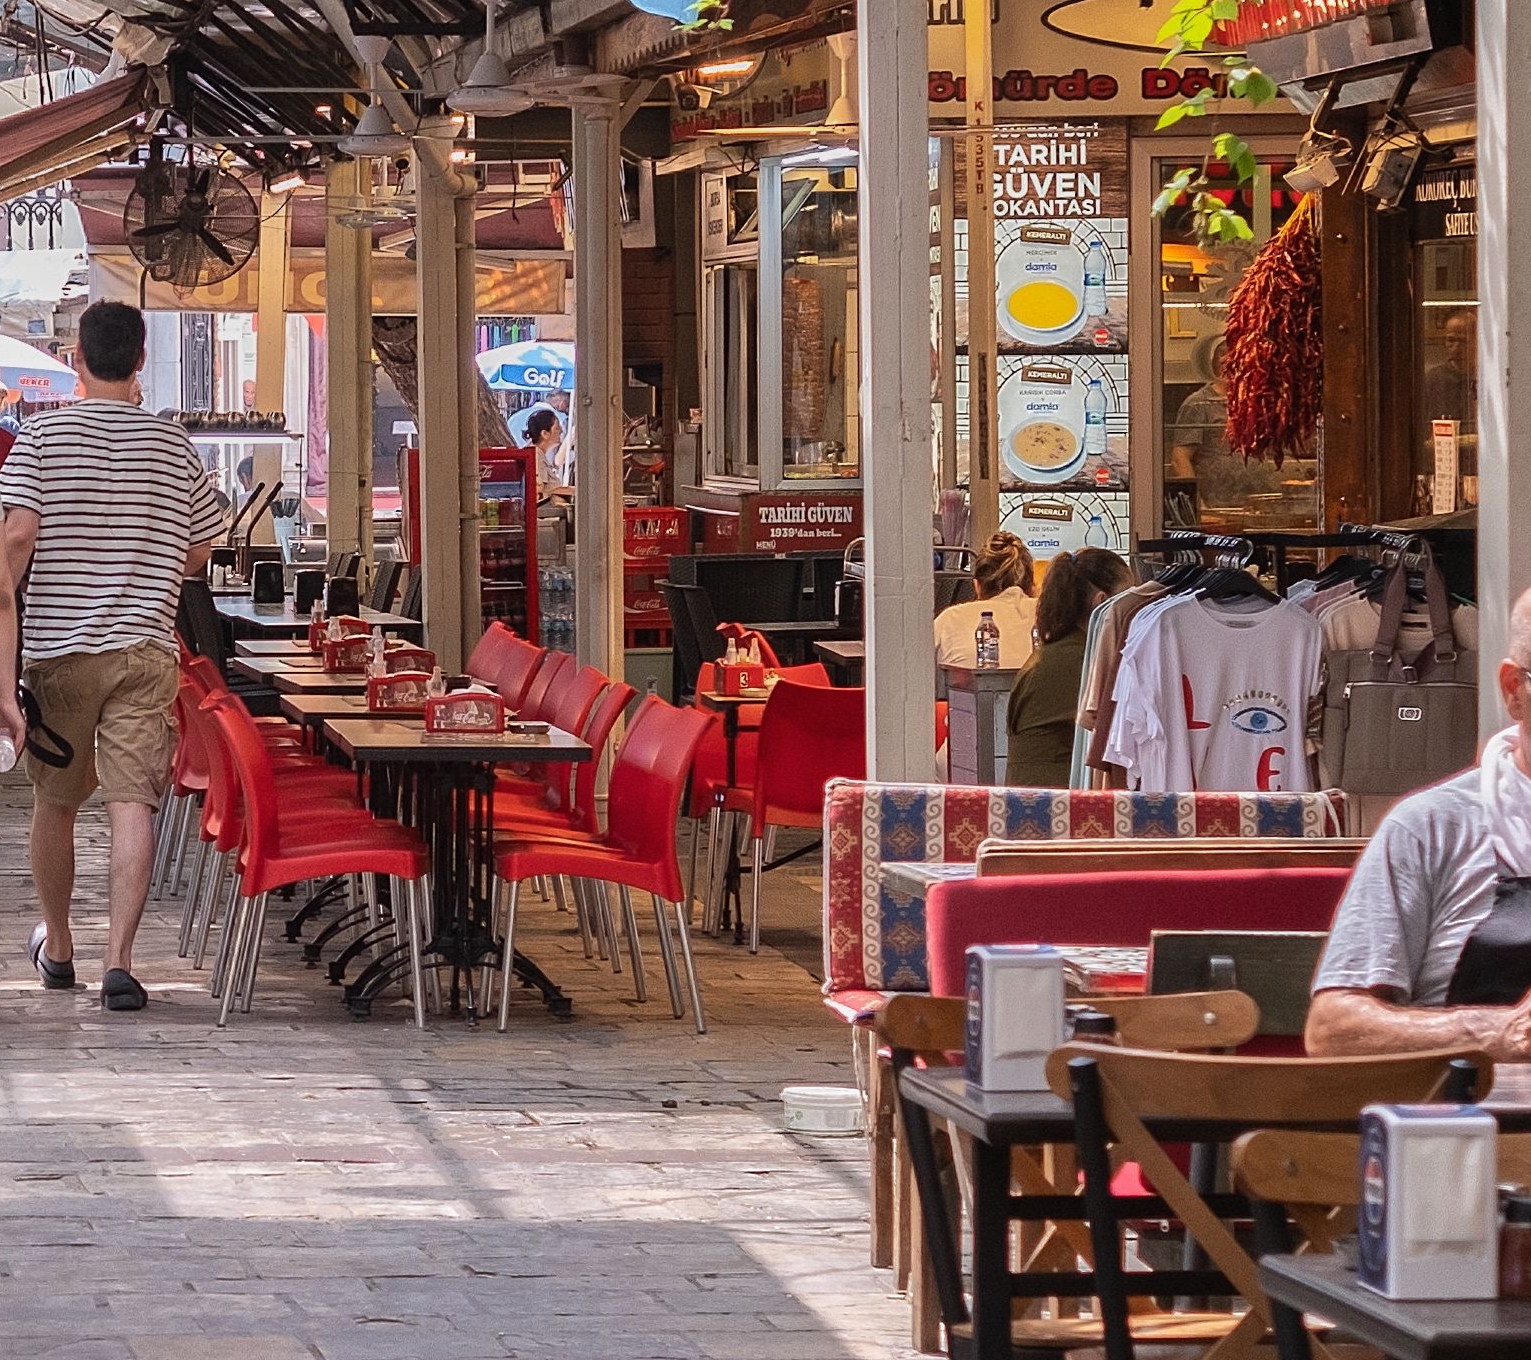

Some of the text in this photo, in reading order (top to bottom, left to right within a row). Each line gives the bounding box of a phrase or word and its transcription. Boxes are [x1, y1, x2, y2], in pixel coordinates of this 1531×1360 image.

[928, 69, 1119, 102] öürde
[993, 139, 1087, 166] TARİHİ
[993, 166, 1101, 199] GÜVEN
[993, 199, 1101, 217] OKANTASI
[523, 367, 565, 389] Golf
[759, 502, 854, 524] TARİHİ GÜVEN
[739, 672, 749, 688] 3
